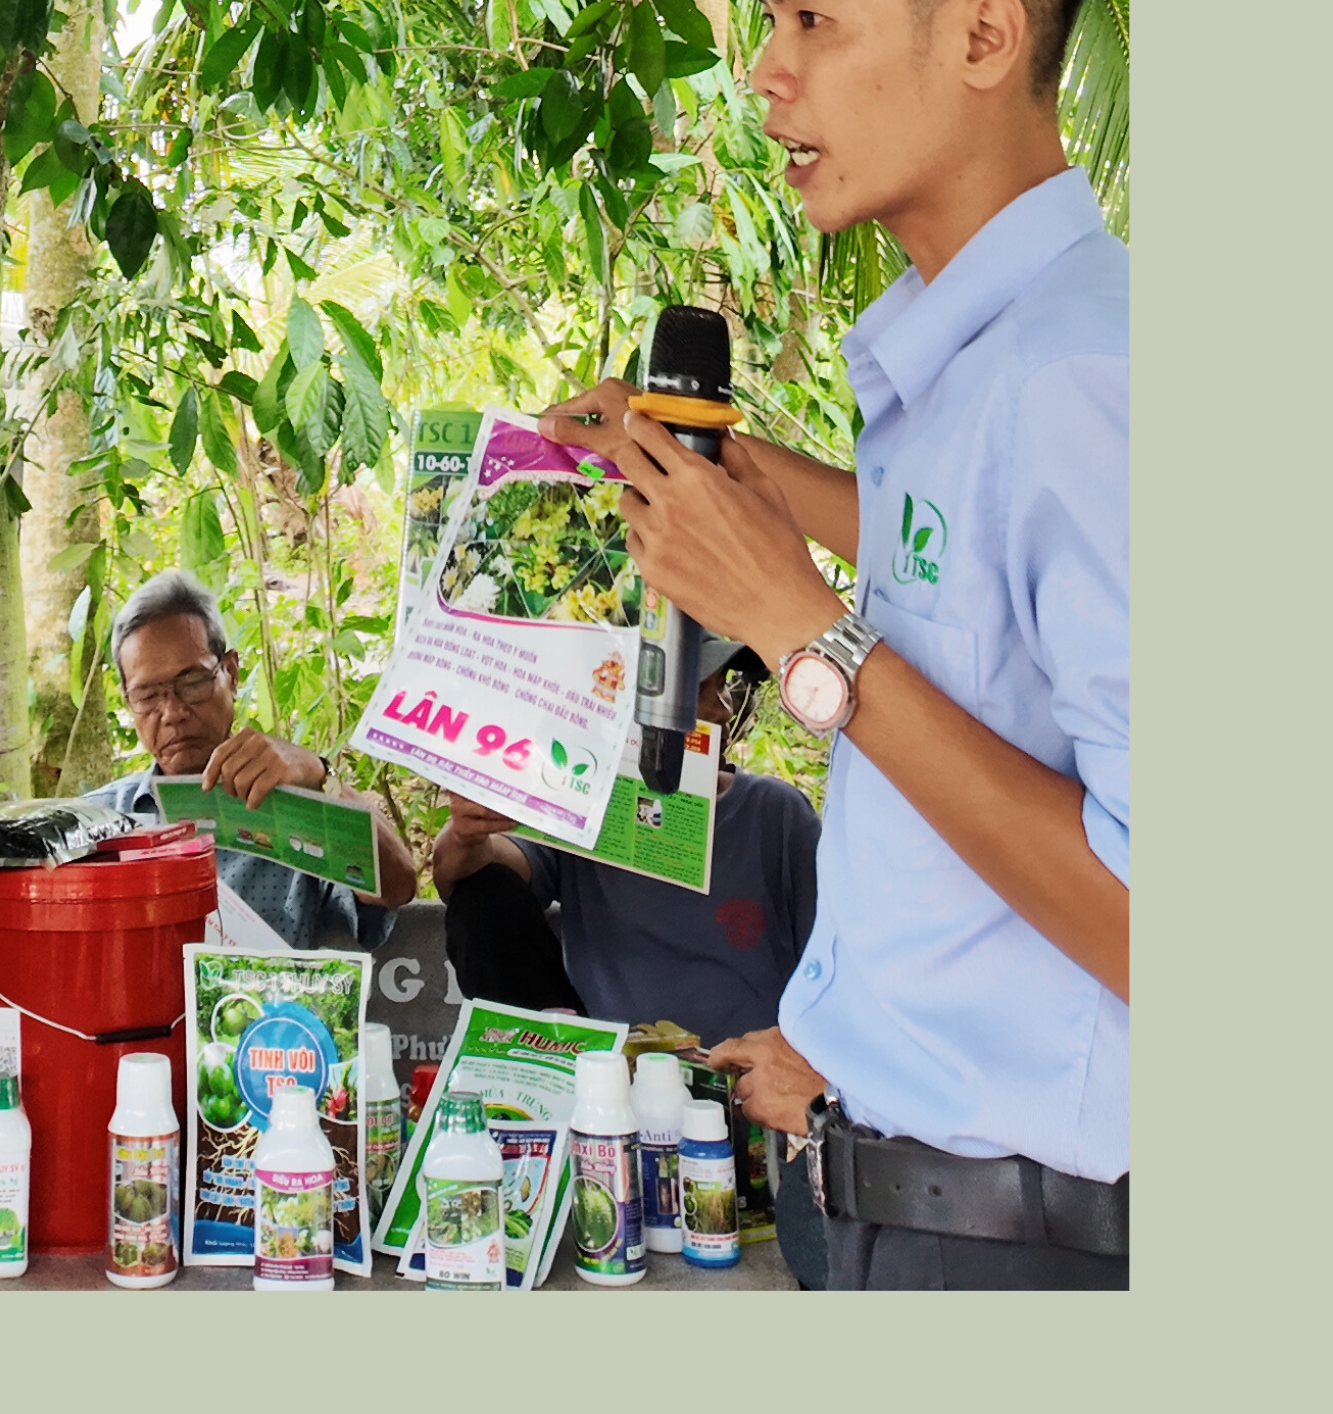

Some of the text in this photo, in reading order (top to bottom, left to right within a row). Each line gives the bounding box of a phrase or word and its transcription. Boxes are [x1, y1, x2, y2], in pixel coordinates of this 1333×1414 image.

[382, 687, 533, 772] LÂN 96
[568, 775, 591, 796] TSC
[518, 1029, 587, 1055] HUMIC
[248, 1045, 316, 1072] TINH VÔI
